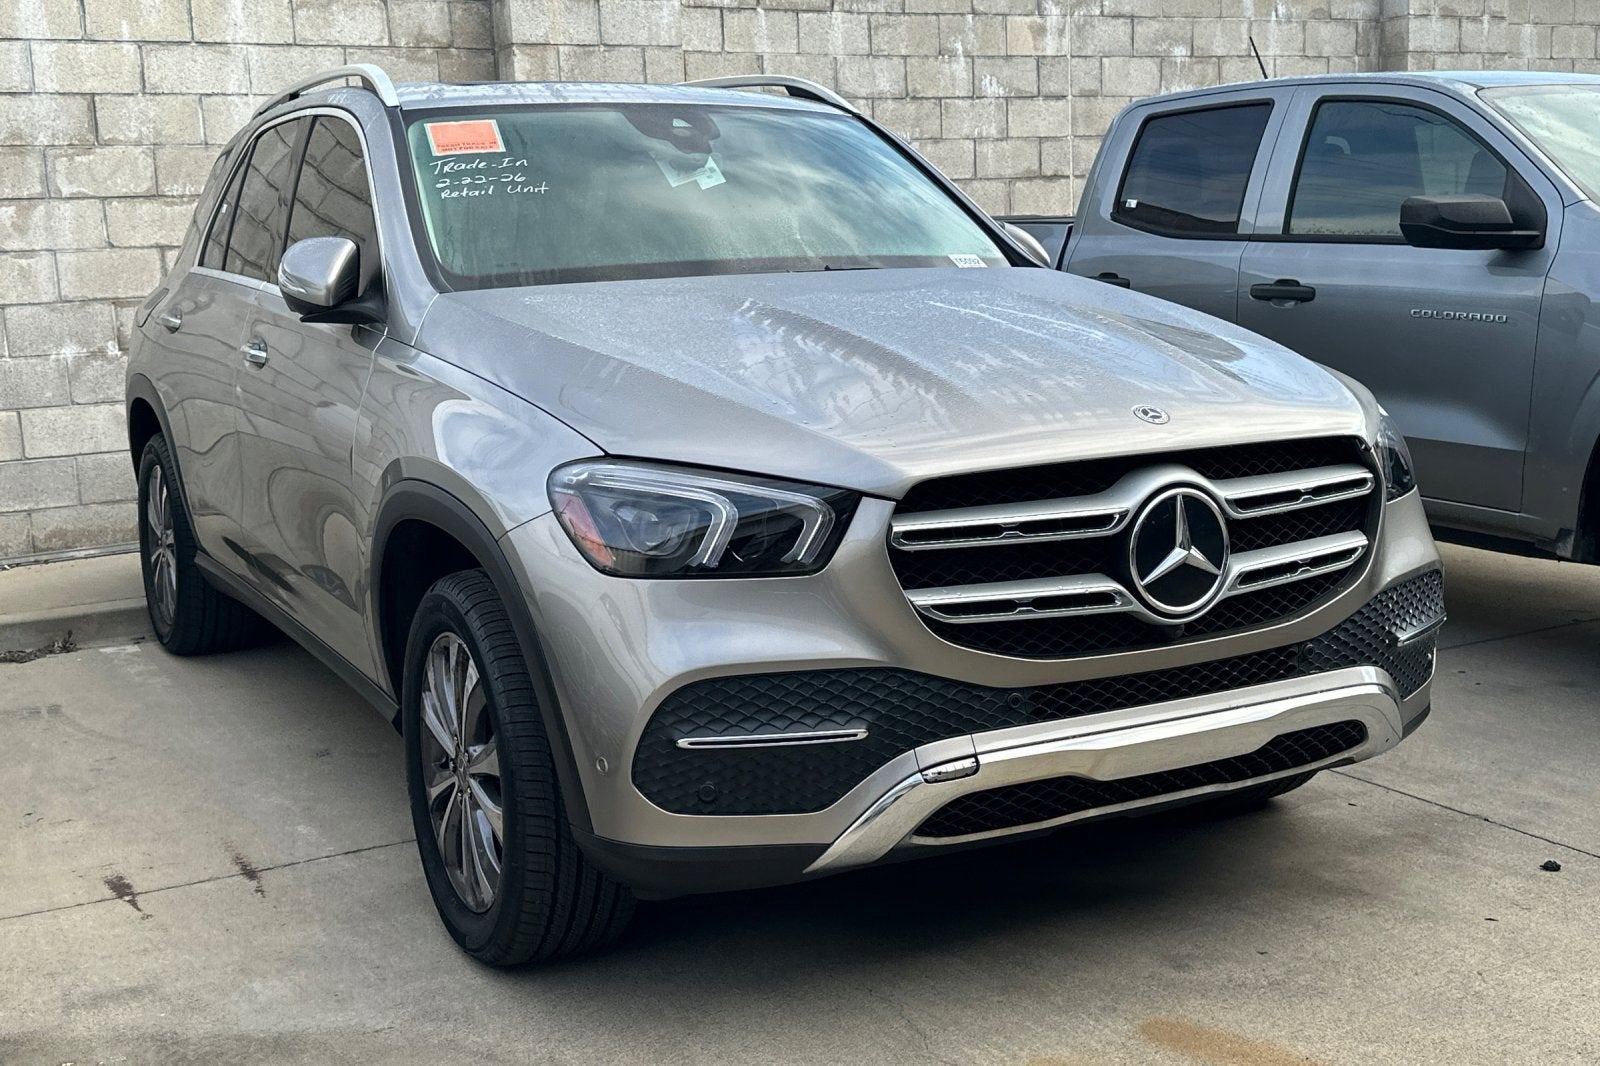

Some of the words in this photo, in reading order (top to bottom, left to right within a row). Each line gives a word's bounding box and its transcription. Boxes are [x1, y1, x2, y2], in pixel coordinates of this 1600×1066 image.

[435, 173, 527, 188] 2-22-26
[441, 185, 495, 199] Retail
[1410, 309, 1508, 323] COLORADO
